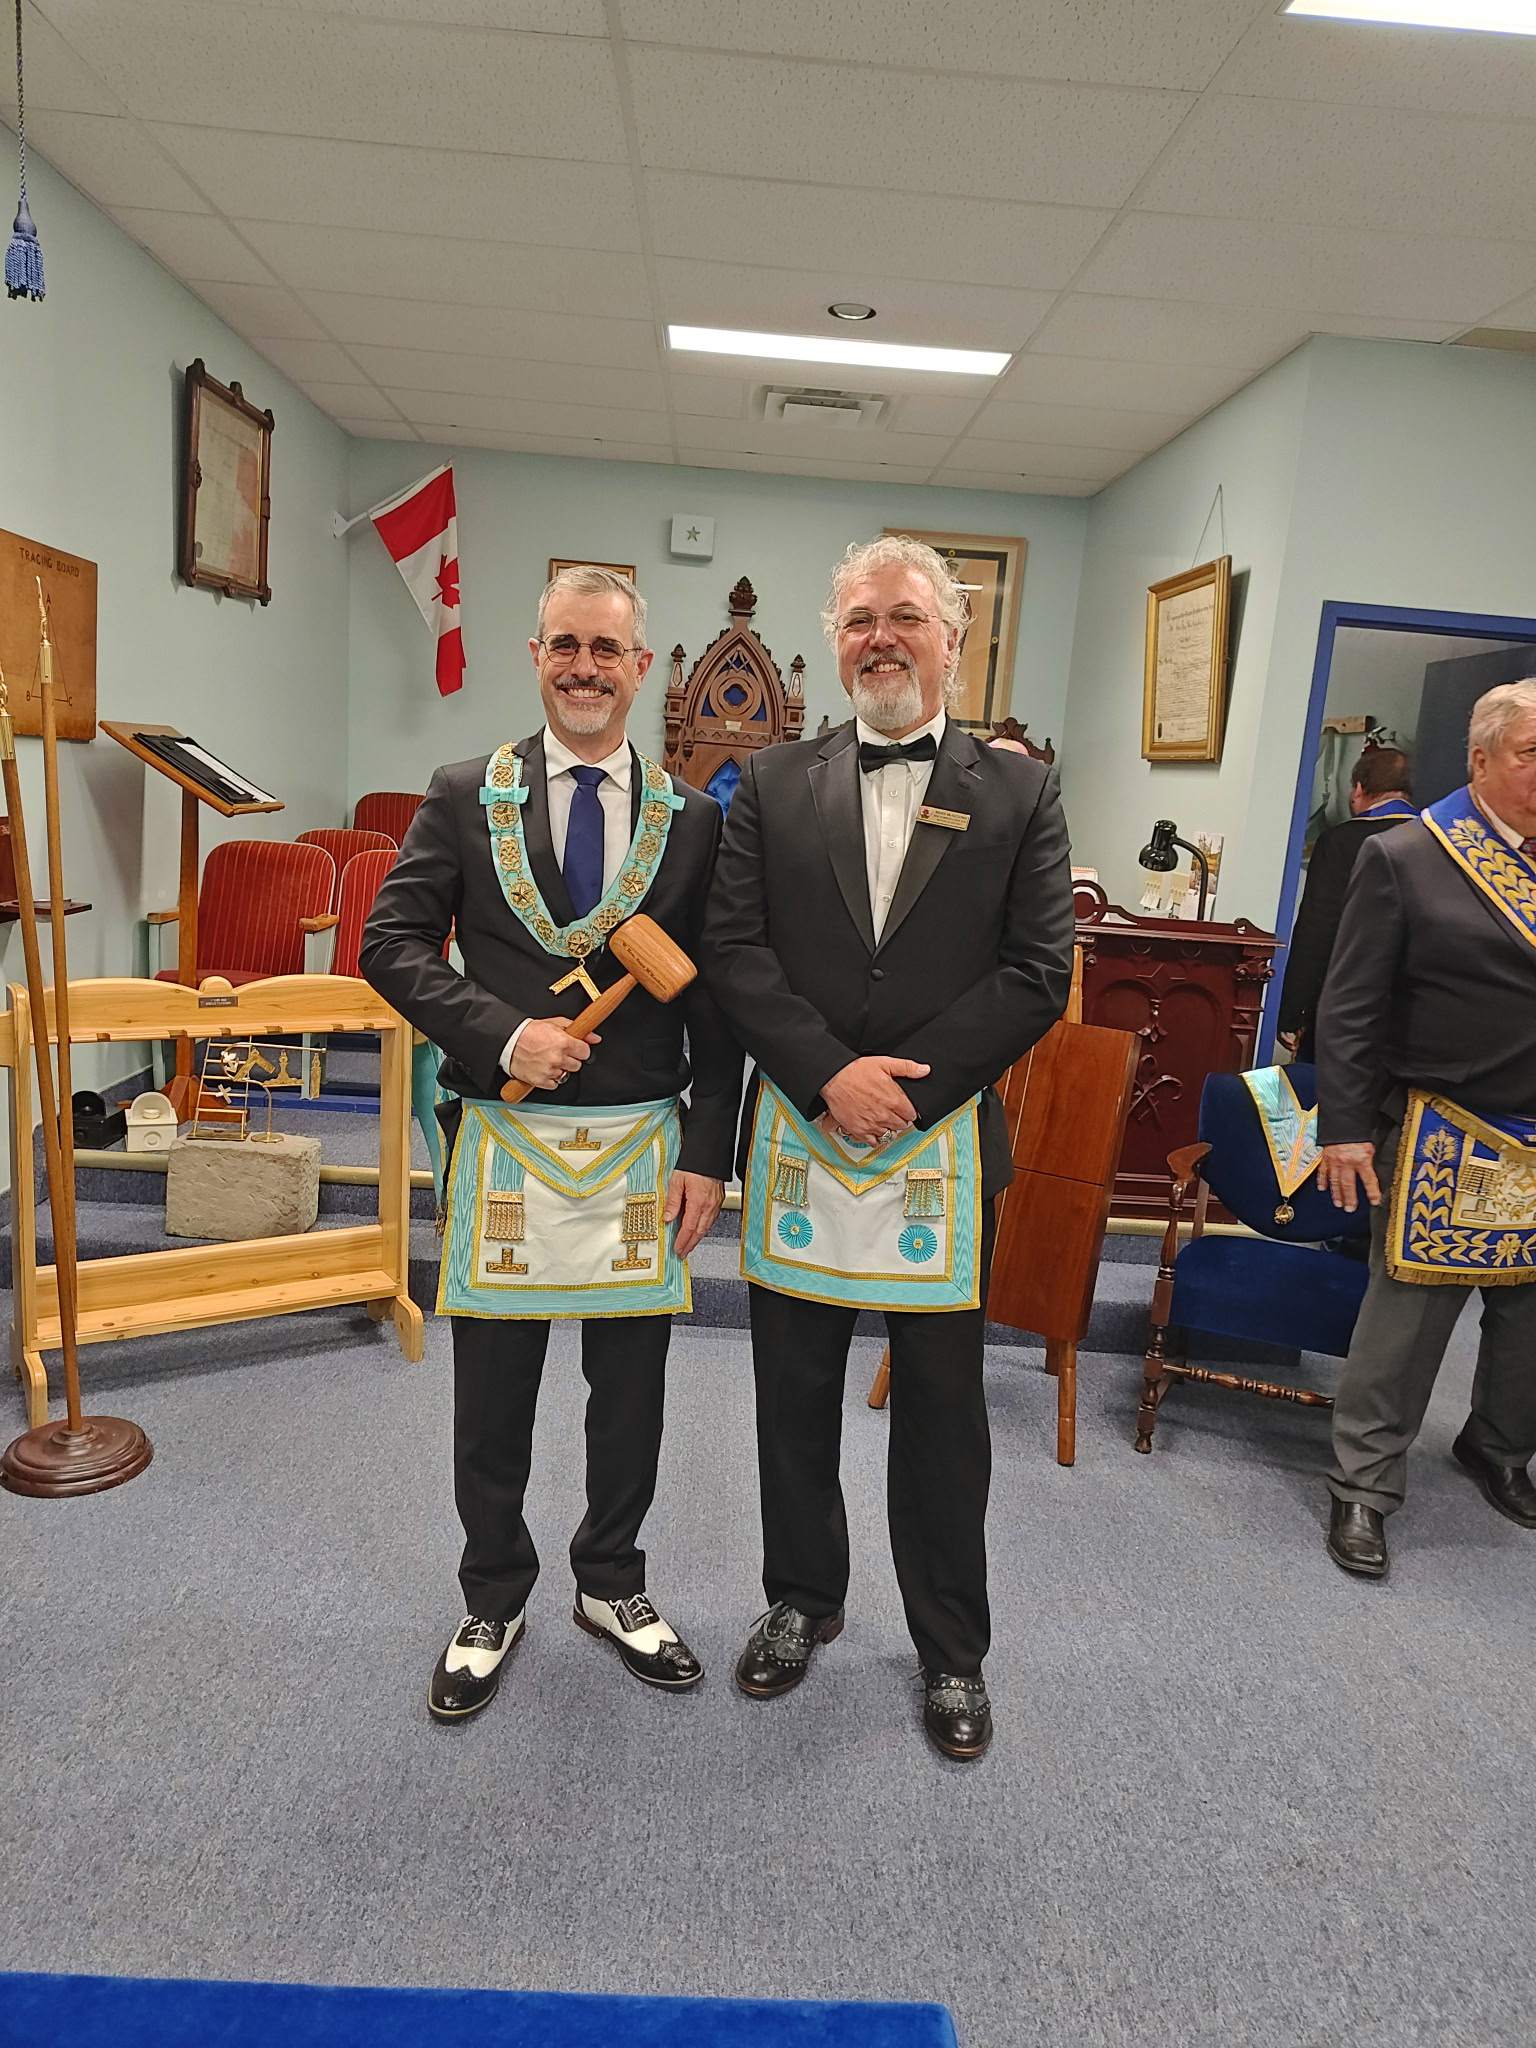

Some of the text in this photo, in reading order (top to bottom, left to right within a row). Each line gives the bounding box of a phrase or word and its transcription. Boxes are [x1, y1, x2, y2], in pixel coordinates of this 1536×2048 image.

[19, 547, 79, 577] TRACING BOARD
[46, 593, 51, 604] A
[26, 690, 31, 701] B
